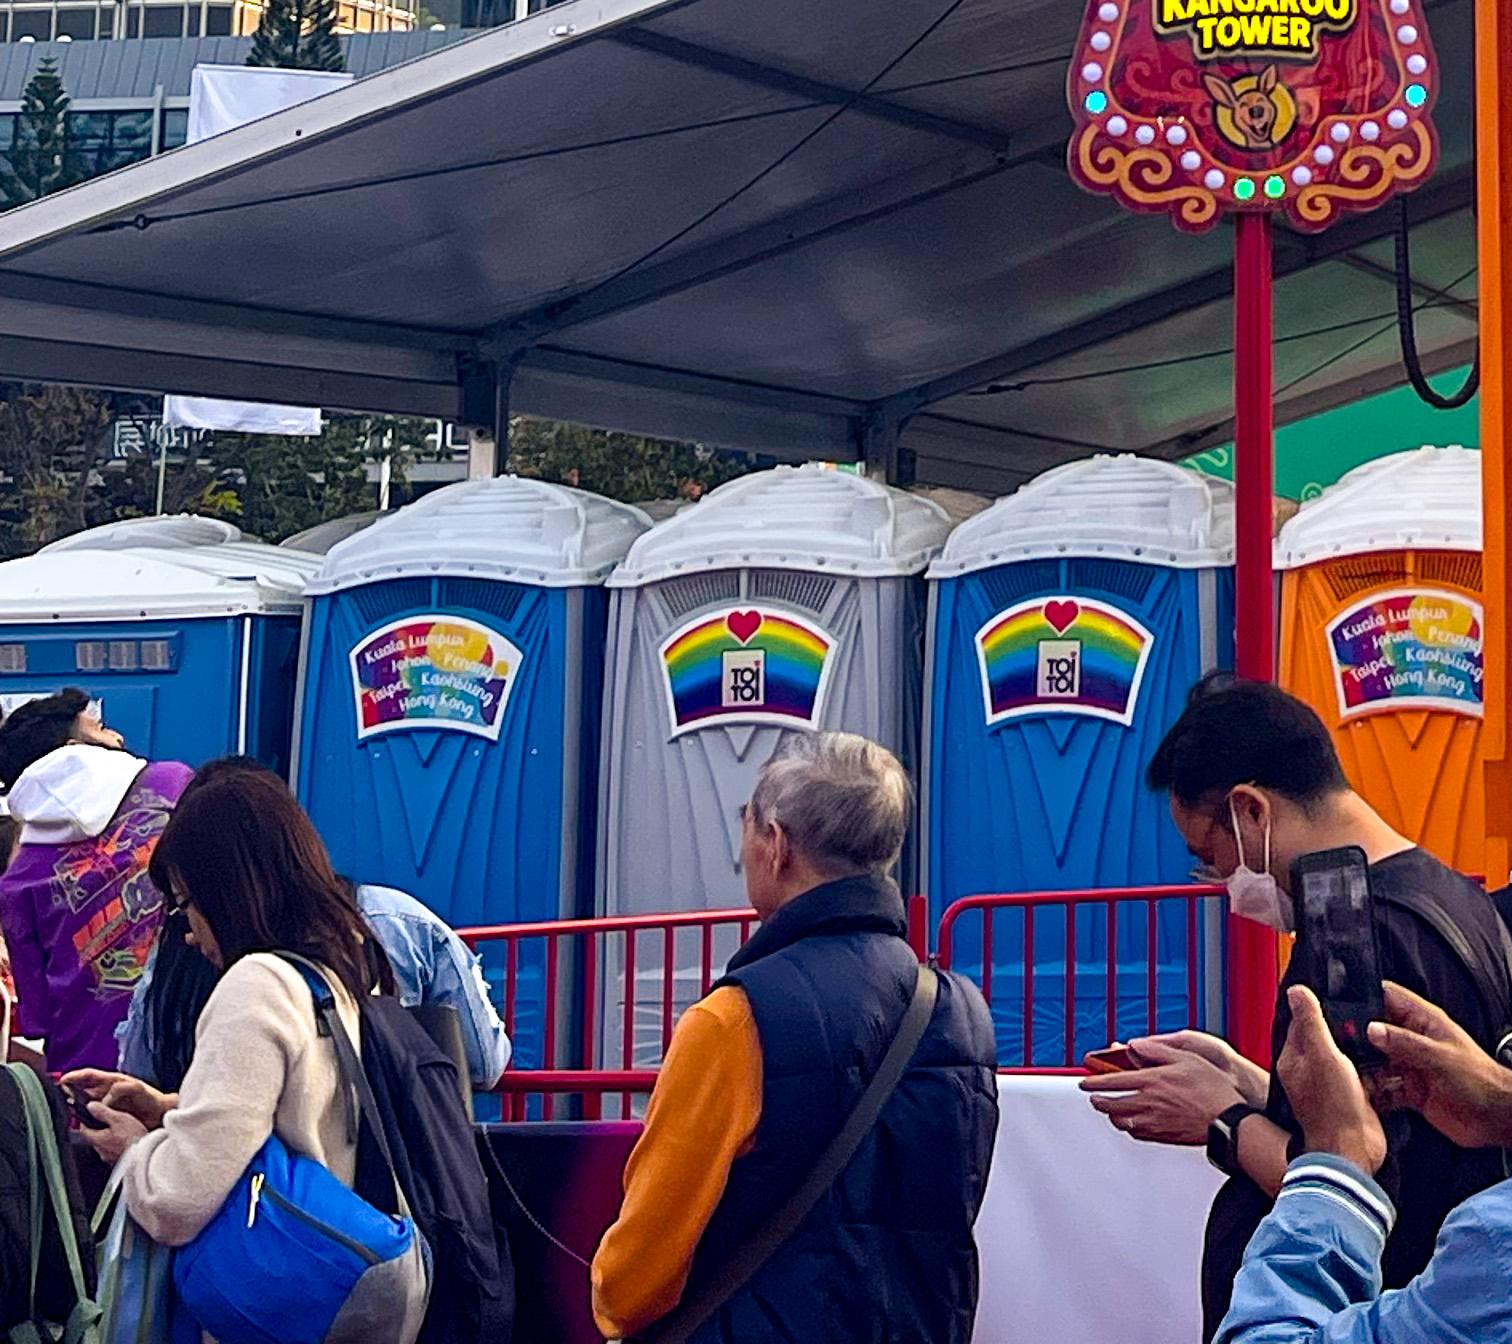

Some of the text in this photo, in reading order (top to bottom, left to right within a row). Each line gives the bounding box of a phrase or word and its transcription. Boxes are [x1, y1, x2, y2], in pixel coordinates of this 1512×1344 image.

[1197, 16, 1312, 49] TOWER
[1341, 613, 1386, 641] Kuala
[364, 638, 406, 664] Kuala
[1383, 668, 1466, 696] Hong Kong
[398, 693, 474, 719] Hong Kong
